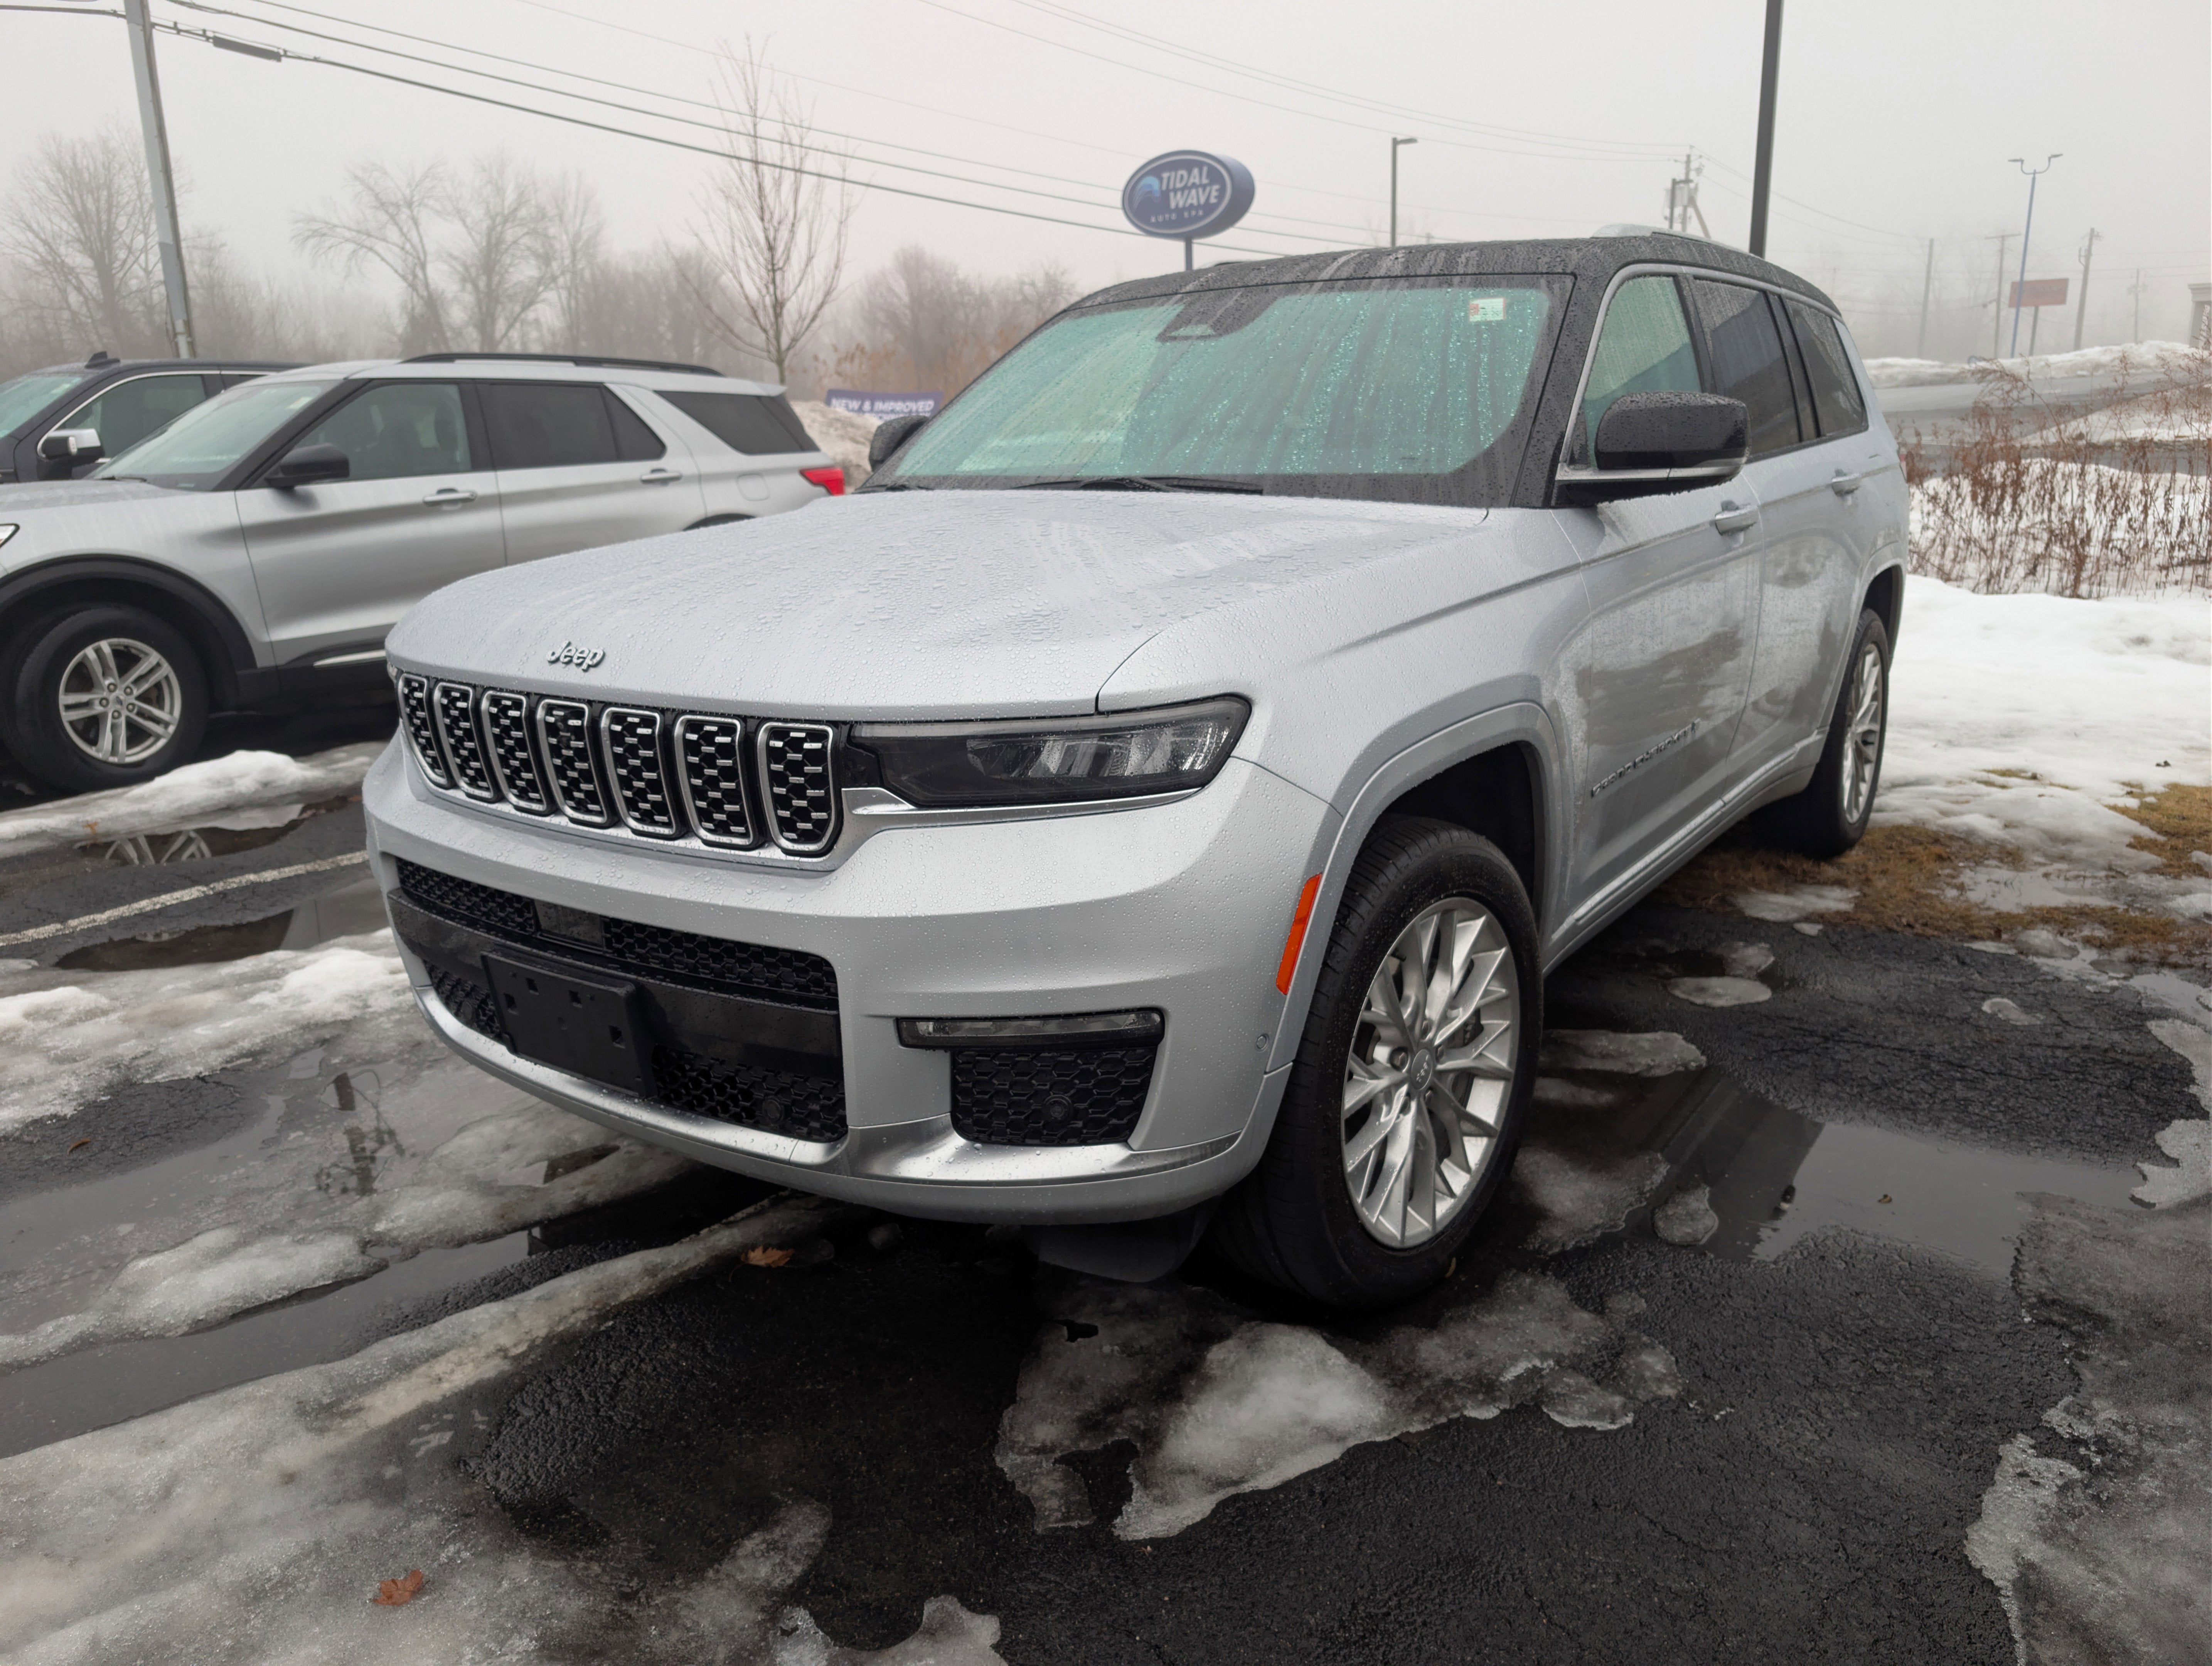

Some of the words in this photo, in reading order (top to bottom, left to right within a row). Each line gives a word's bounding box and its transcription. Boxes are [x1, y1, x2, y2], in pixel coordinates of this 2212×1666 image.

[1161, 166, 1210, 191] TIDAL
[1169, 184, 1220, 209] WAVE
[1150, 213, 1177, 223] AUTO
[830, 398, 862, 411] NEW
[862, 399, 871, 411] &
[873, 399, 935, 413] IMPROVED
[546, 639, 605, 672] Jeep
